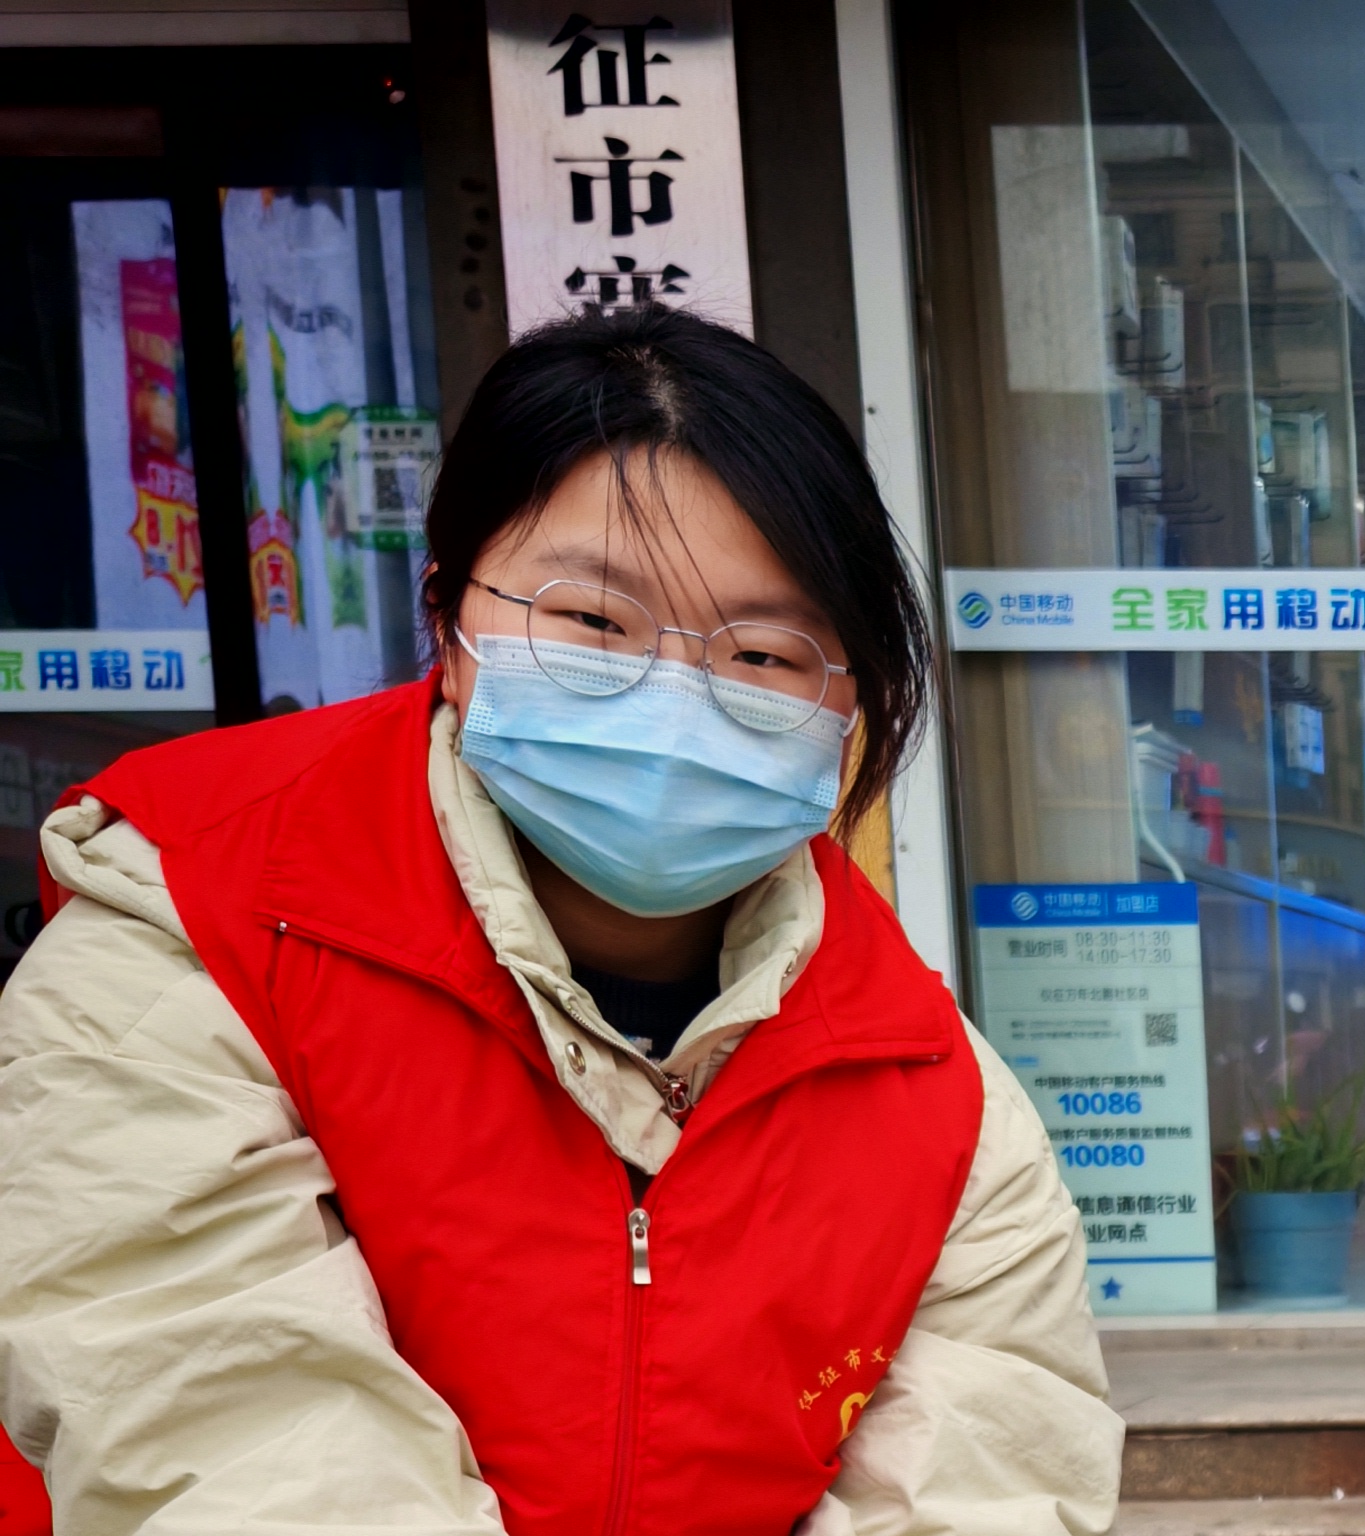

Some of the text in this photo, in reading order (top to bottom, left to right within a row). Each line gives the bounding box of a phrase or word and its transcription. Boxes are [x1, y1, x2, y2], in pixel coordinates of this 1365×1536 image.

[1000, 593, 1074, 612] 中国移动
[1002, 614, 1074, 626] China Mobile
[1116, 895, 1160, 914] 加盟店
[1008, 939, 1068, 959] 营业时间
[1034, 1075, 1166, 1090] 中国移动客户服务热线
[1058, 1092, 1142, 1116] 10086
[1060, 1144, 1145, 1168] 10080
[1083, 1221, 1149, 1244] 业网点
